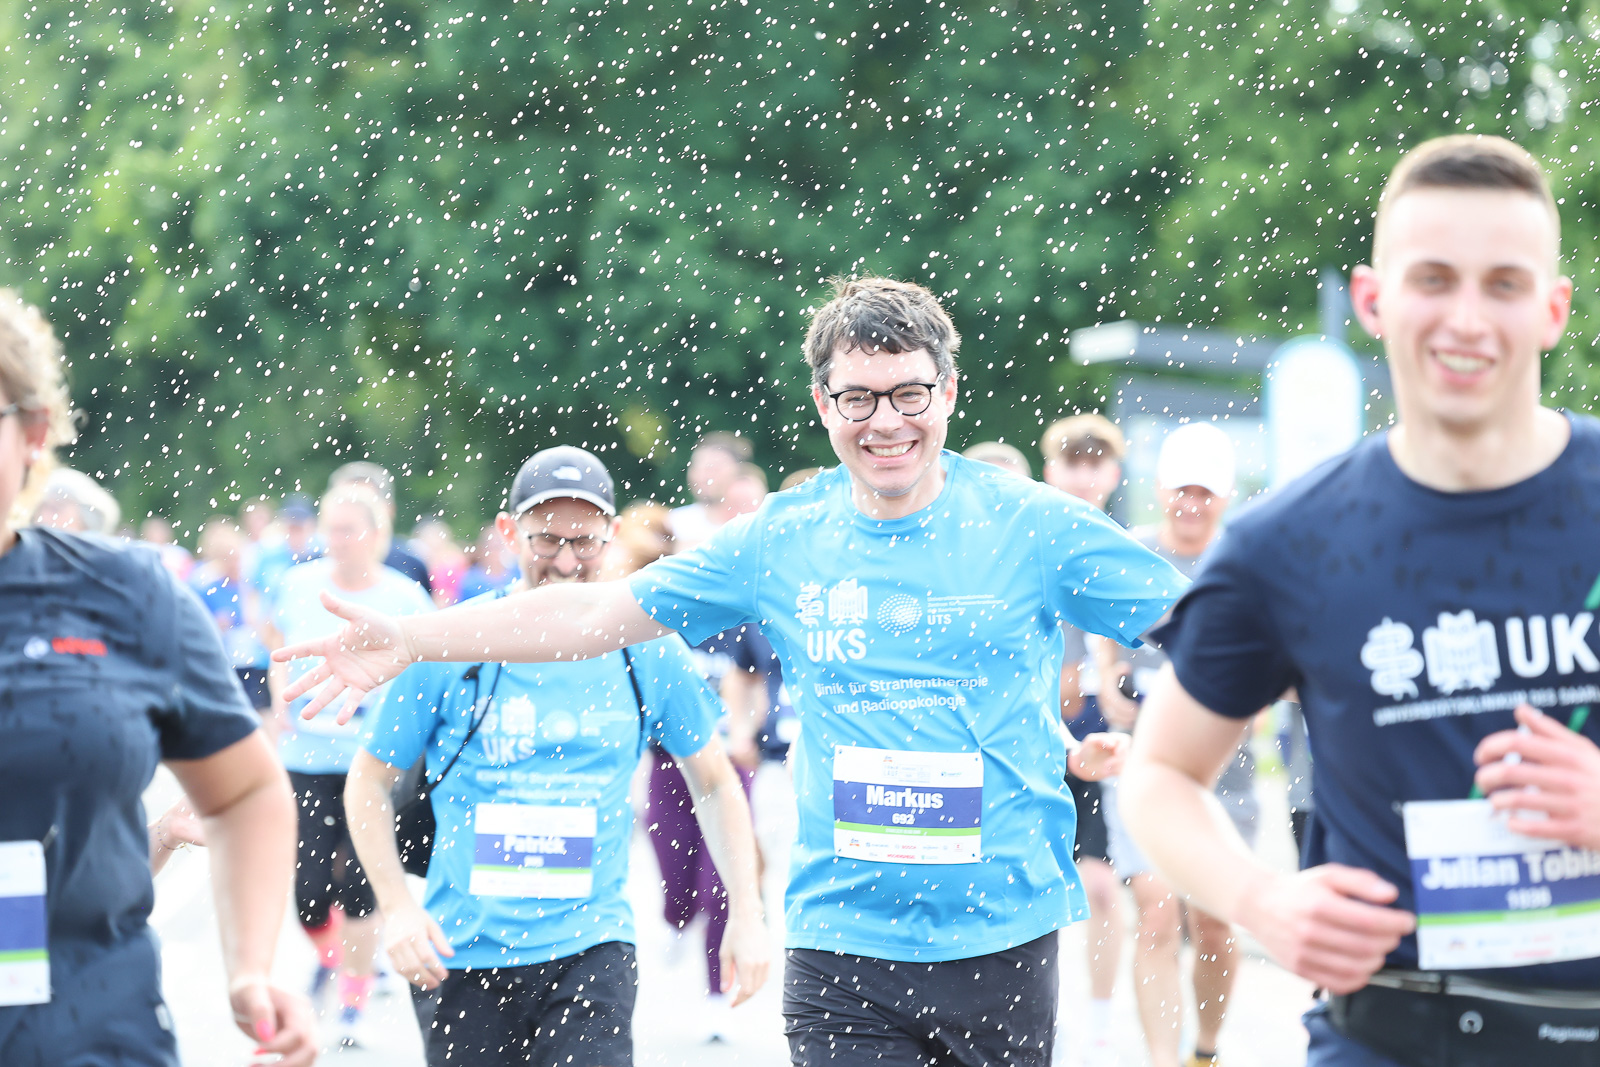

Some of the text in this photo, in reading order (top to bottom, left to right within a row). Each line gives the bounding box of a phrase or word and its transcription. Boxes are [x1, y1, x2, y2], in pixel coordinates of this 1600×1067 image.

[926, 613, 952, 626] UTS
[806, 628, 867, 663] UKS
[1504, 610, 1600, 679] UK
[833, 700, 859, 715] und
[481, 735, 535, 764] UKS
[865, 784, 944, 809] Markus
[892, 812, 915, 825] 692
[503, 834, 566, 855] Patrick
[1420, 854, 1520, 891] Julian
